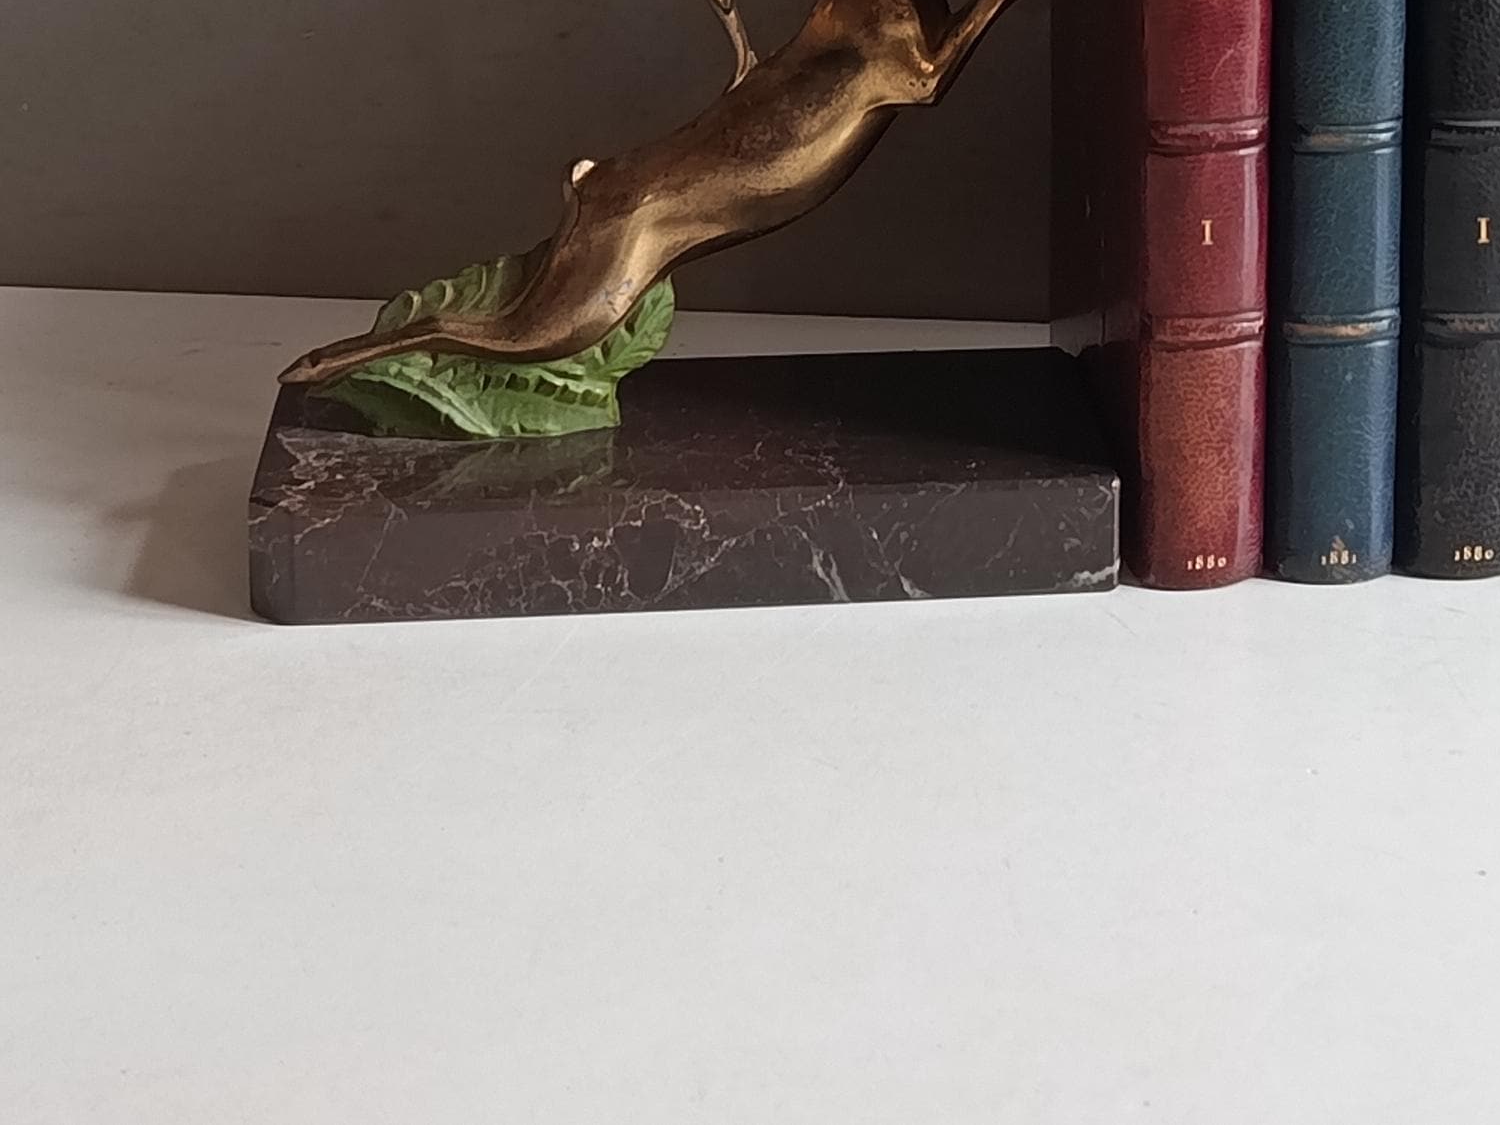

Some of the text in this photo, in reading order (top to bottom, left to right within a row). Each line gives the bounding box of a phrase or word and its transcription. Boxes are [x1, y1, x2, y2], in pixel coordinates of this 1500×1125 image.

[1202, 220, 1213, 245] I
[1477, 217, 1490, 244] I
[1188, 554, 1226, 570] 1880
[1454, 546, 1494, 562] 1880
